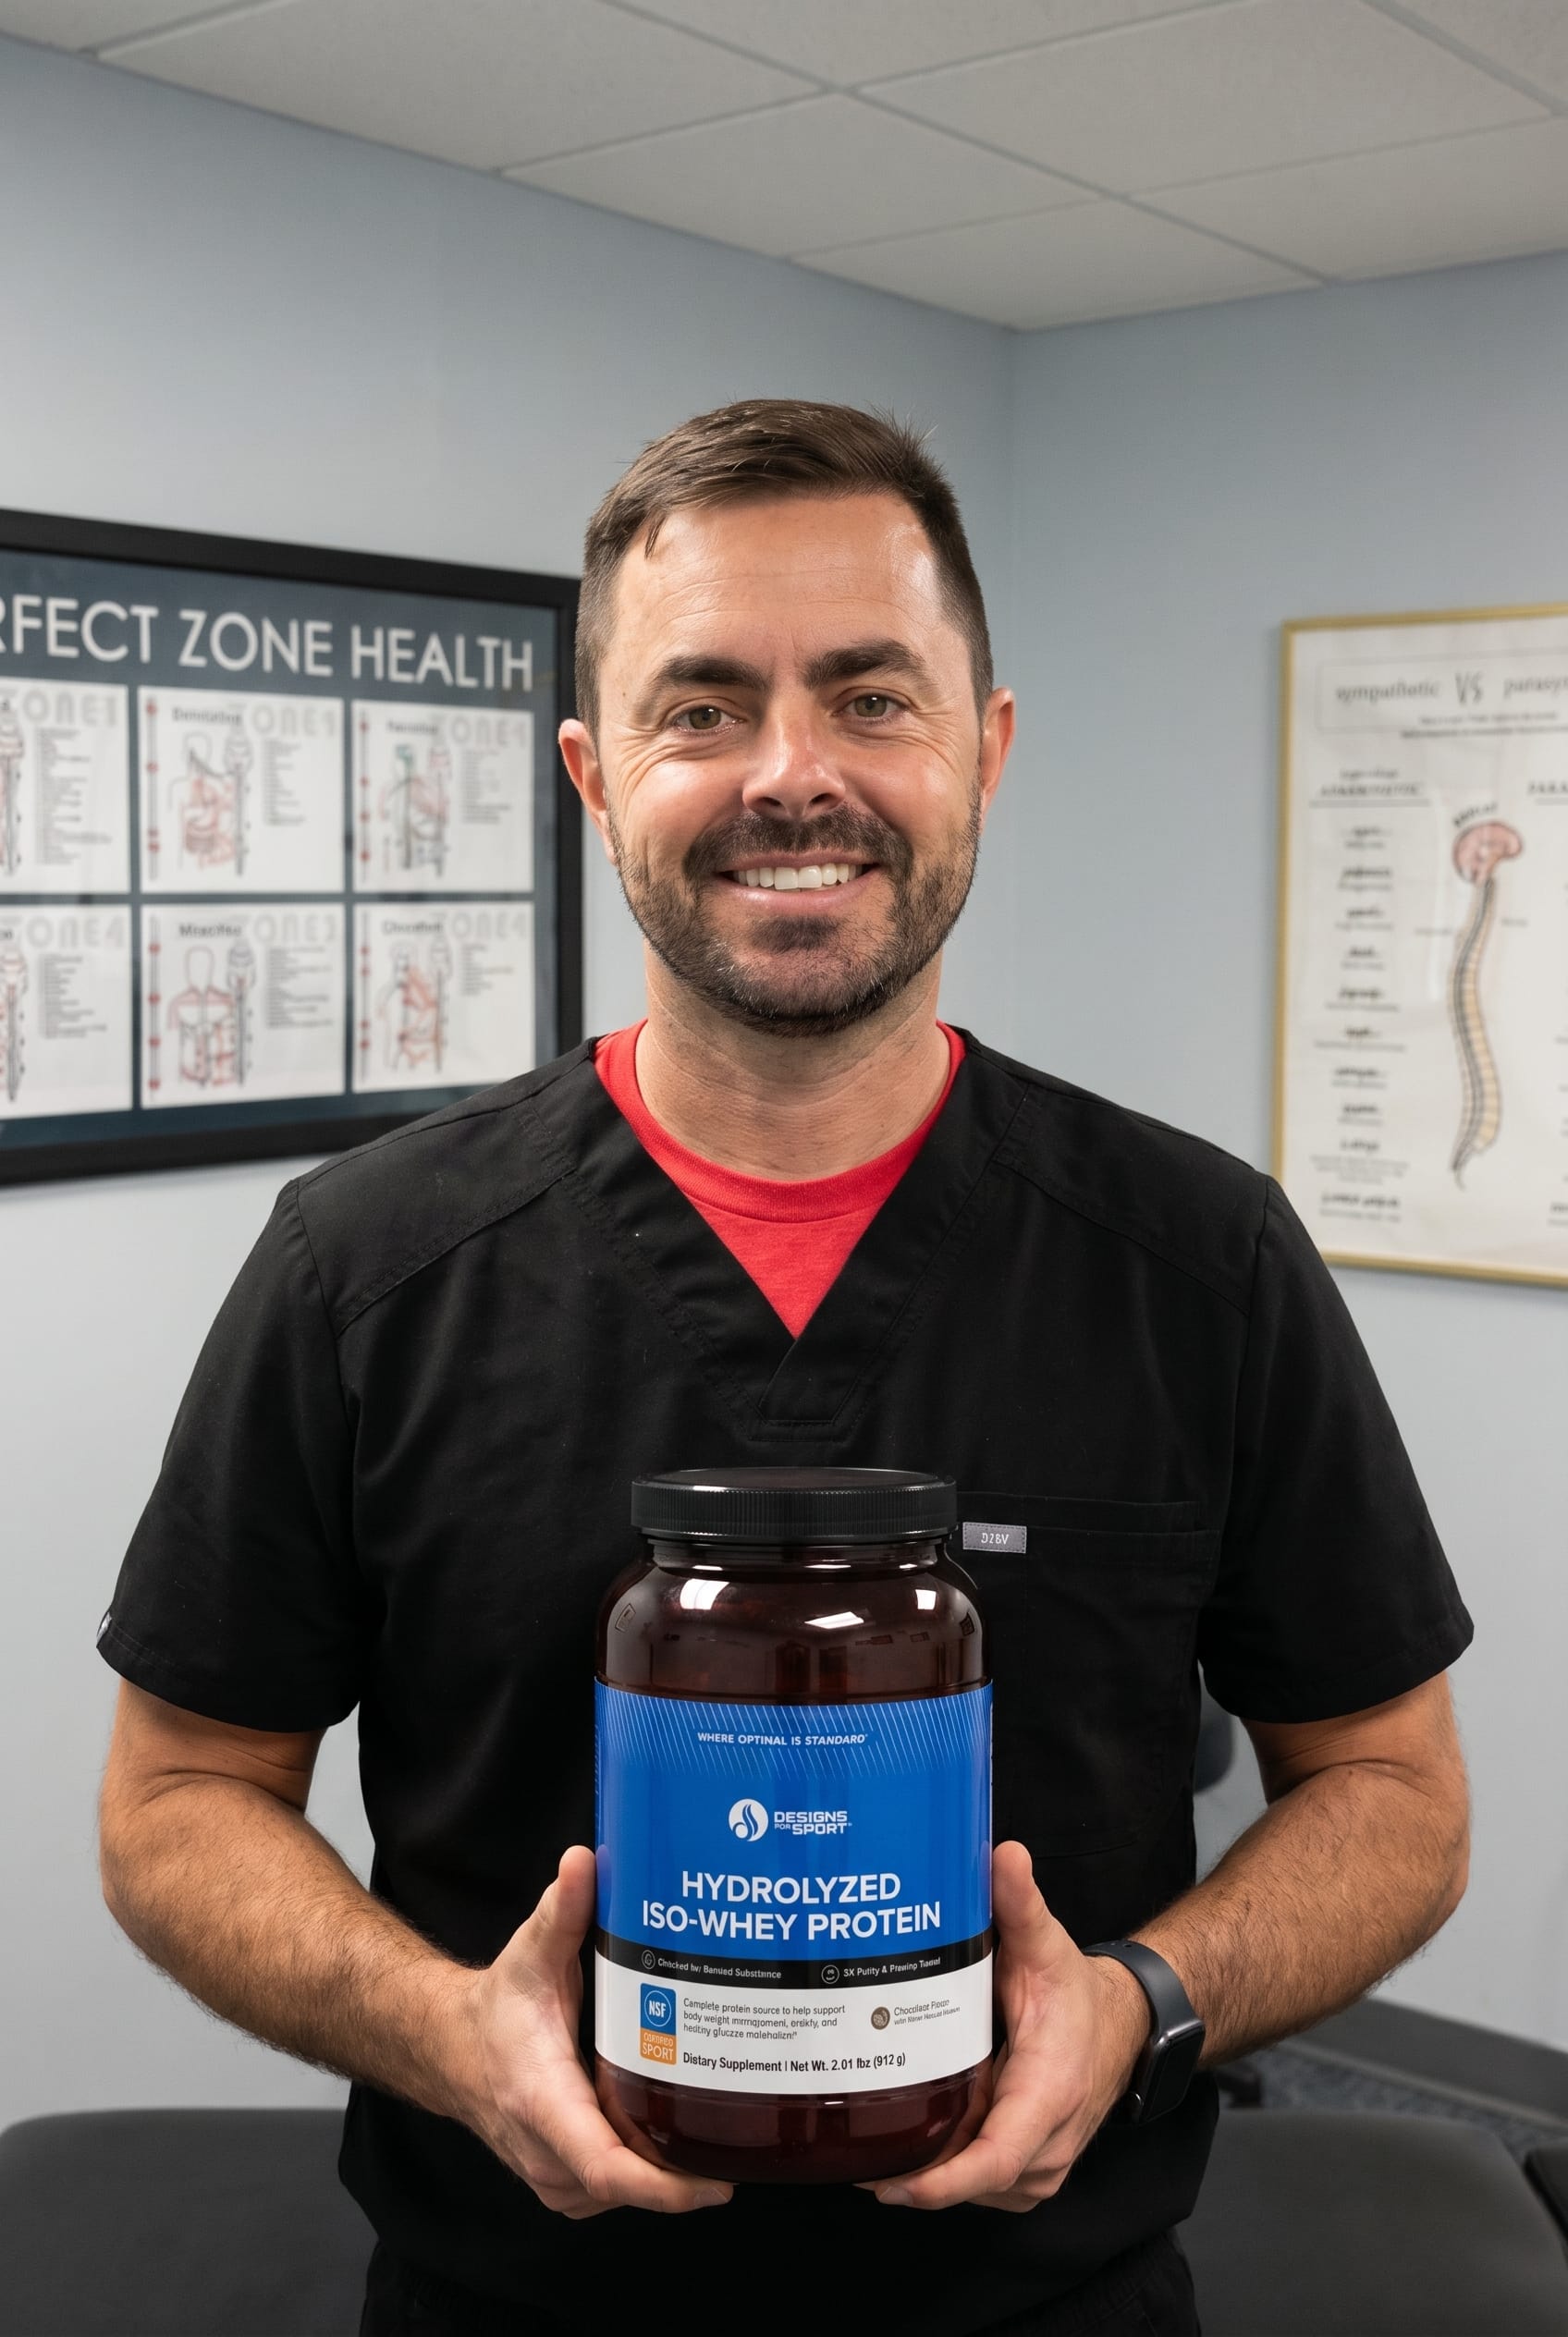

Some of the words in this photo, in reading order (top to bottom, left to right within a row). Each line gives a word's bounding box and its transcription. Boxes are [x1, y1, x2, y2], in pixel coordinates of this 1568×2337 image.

[178, 609, 334, 677] ZONE
[350, 623, 533, 691] HEALTH
[697, 1732, 735, 1744] WHERE
[791, 1736, 802, 1745] IS
[774, 1811, 848, 1823] DESIGNS
[791, 1823, 848, 1835] SPORT
[682, 1870, 901, 1904] HYDROLYZED
[643, 1900, 798, 1940] ISO-WHEY
[807, 1901, 941, 1940] PROTEIN
[649, 2000, 667, 2018] NSF
[782, 2006, 790, 2014] to
[792, 2006, 811, 2015] help
[813, 2004, 846, 2016] support
[683, 2011, 703, 2024] body
[704, 2014, 730, 2025] weight
[821, 2018, 838, 2027] and
[643, 2042, 674, 2062] SPORT
[719, 2056, 782, 2072] Supplement
[790, 2061, 809, 2072] Net
[812, 2060, 829, 2072] Wt.
[831, 2058, 853, 2071] 2.01
[873, 2053, 894, 2069] (912
[896, 2051, 906, 2066] g)
